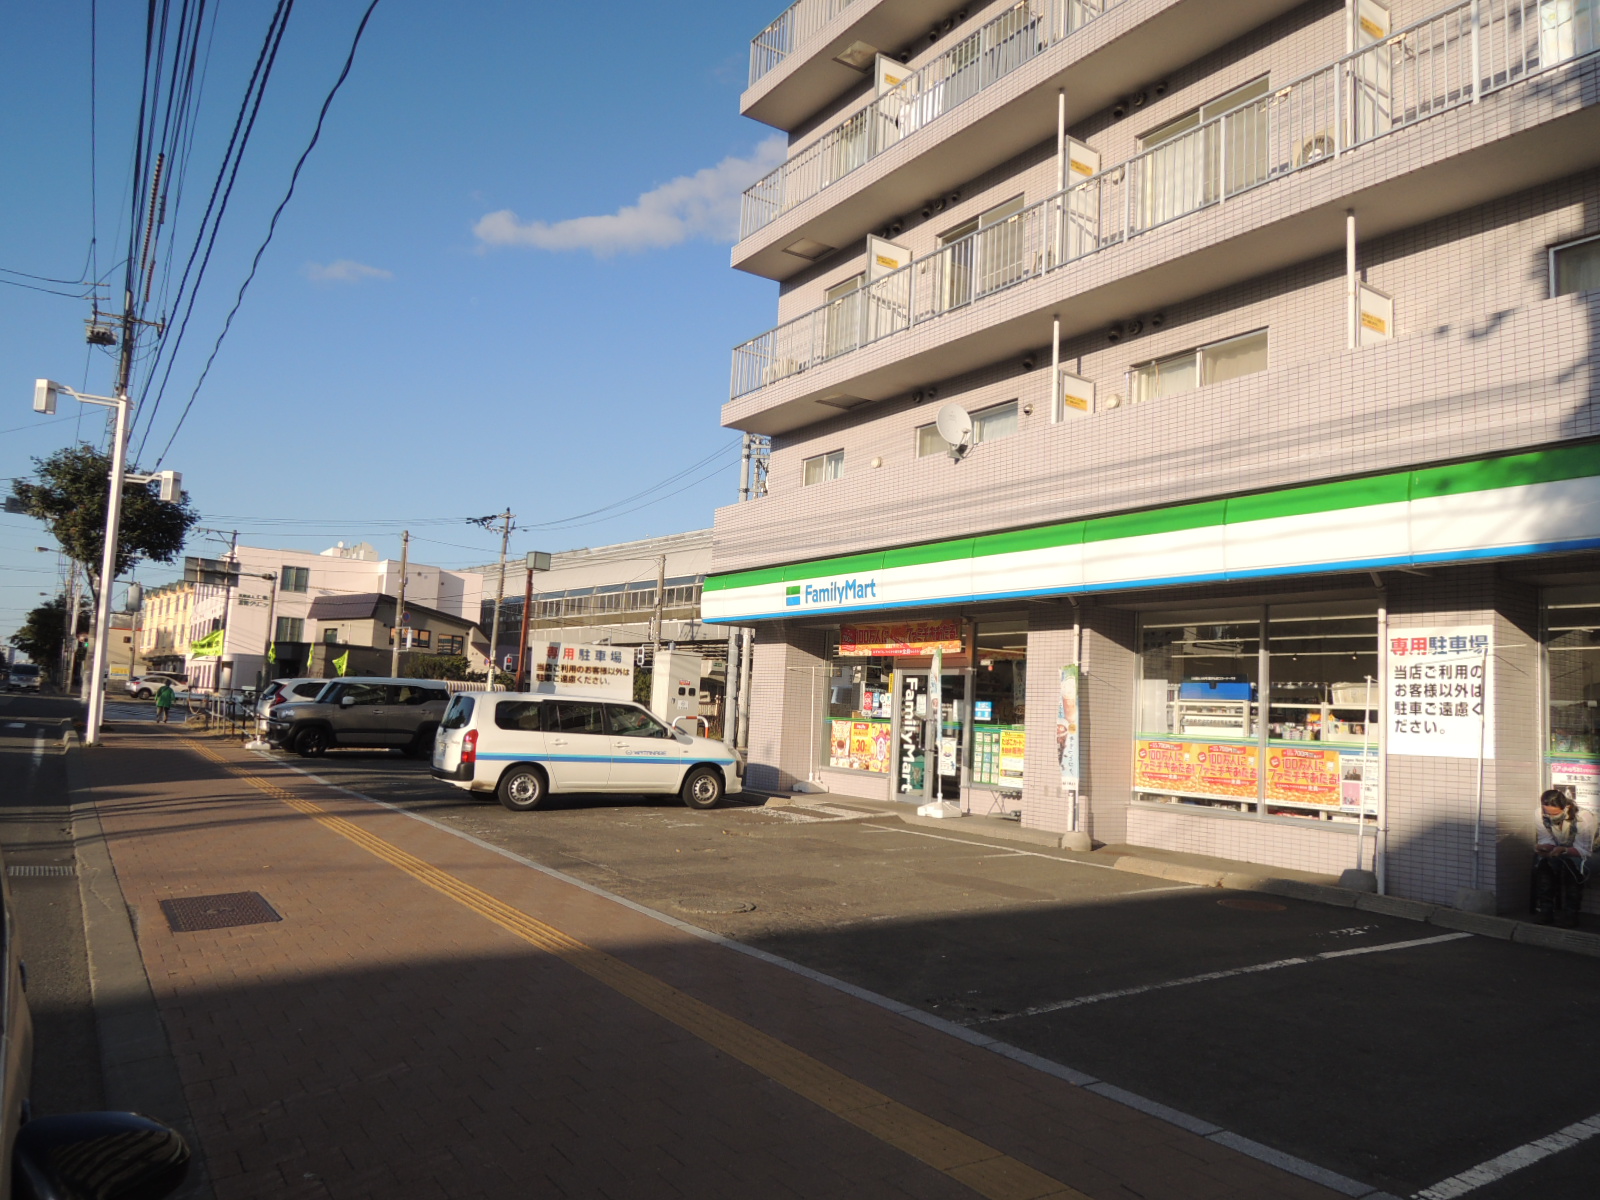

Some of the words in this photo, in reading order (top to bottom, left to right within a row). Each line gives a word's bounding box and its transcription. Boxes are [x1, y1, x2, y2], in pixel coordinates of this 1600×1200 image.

[805, 579, 877, 605] FamilyMart
[1390, 635, 1489, 656] 専用駐車場
[546, 646, 622, 664] 専用駐車場
[536, 663, 630, 676] 当店ご利用のお客様以外は
[1394, 664, 1483, 681] 当店ご利用の
[536, 674, 610, 685] 駐車ご遠慮ください。
[1394, 683, 1483, 699] お客様以外は
[1394, 701, 1482, 718] 駐車ご遠慮く
[900, 677, 920, 793] FamilyMart
[1394, 719, 1446, 735] ださい。
[1148, 750, 1183, 762] 100万人に
[1208, 754, 1247, 766] 100万人に
[1281, 758, 1325, 772] 100万人に
